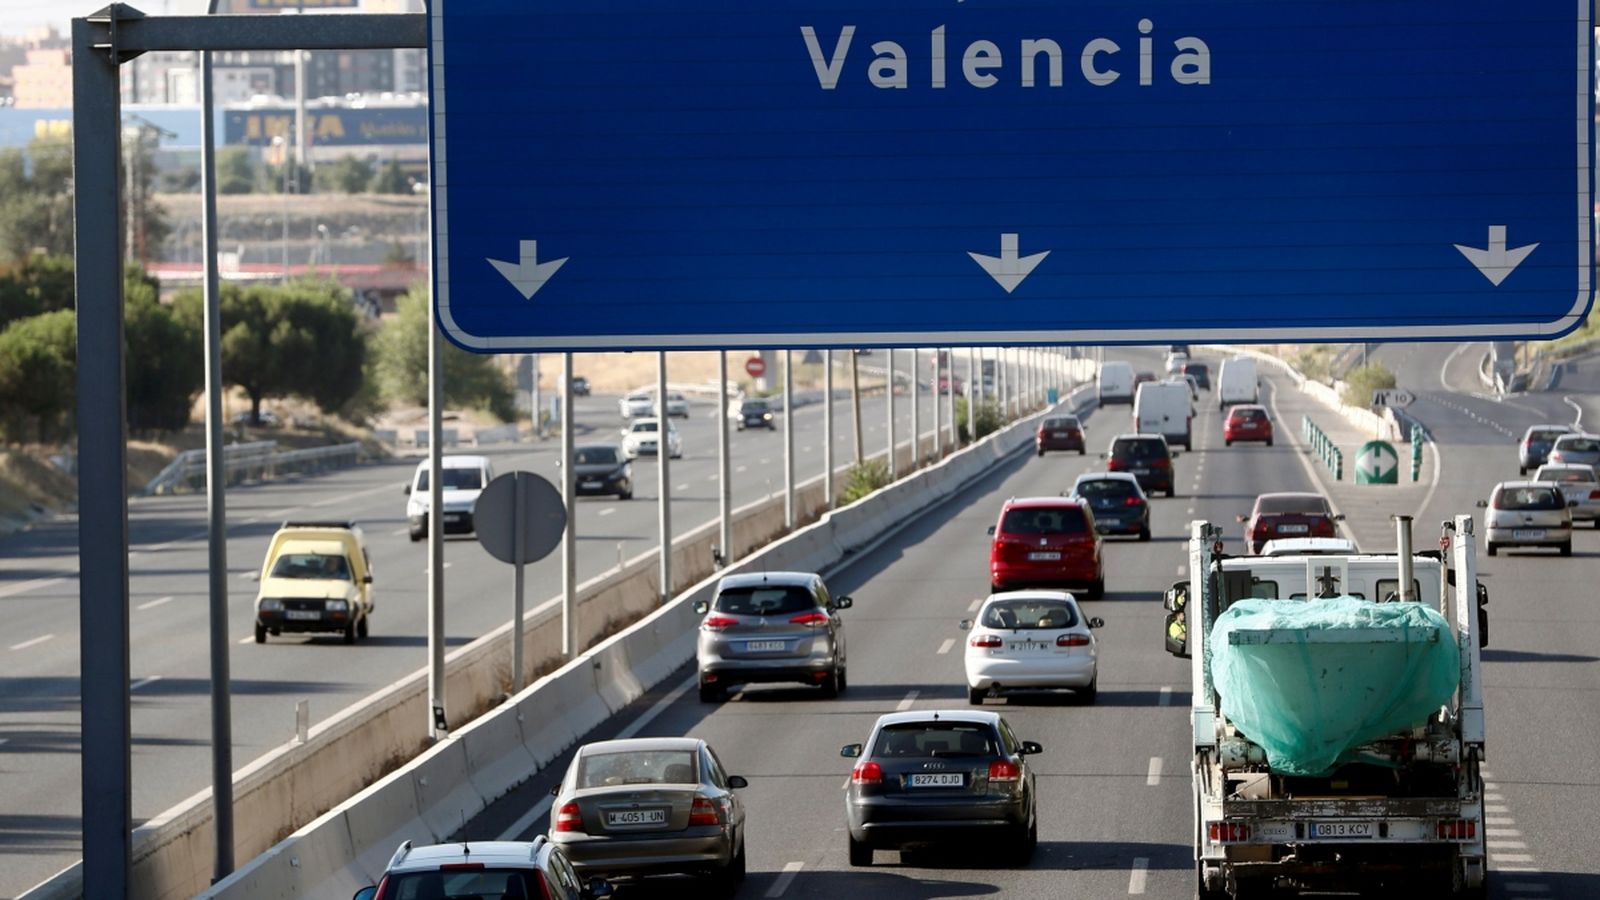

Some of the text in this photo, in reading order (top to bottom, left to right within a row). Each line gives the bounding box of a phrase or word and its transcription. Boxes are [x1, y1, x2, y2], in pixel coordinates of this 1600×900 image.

[800, 18, 1212, 89] Valencia
[1395, 394, 1408, 404] 10
[915, 775, 960, 784] 8274 DJD
[1318, 824, 1369, 835] 0813 KCY
